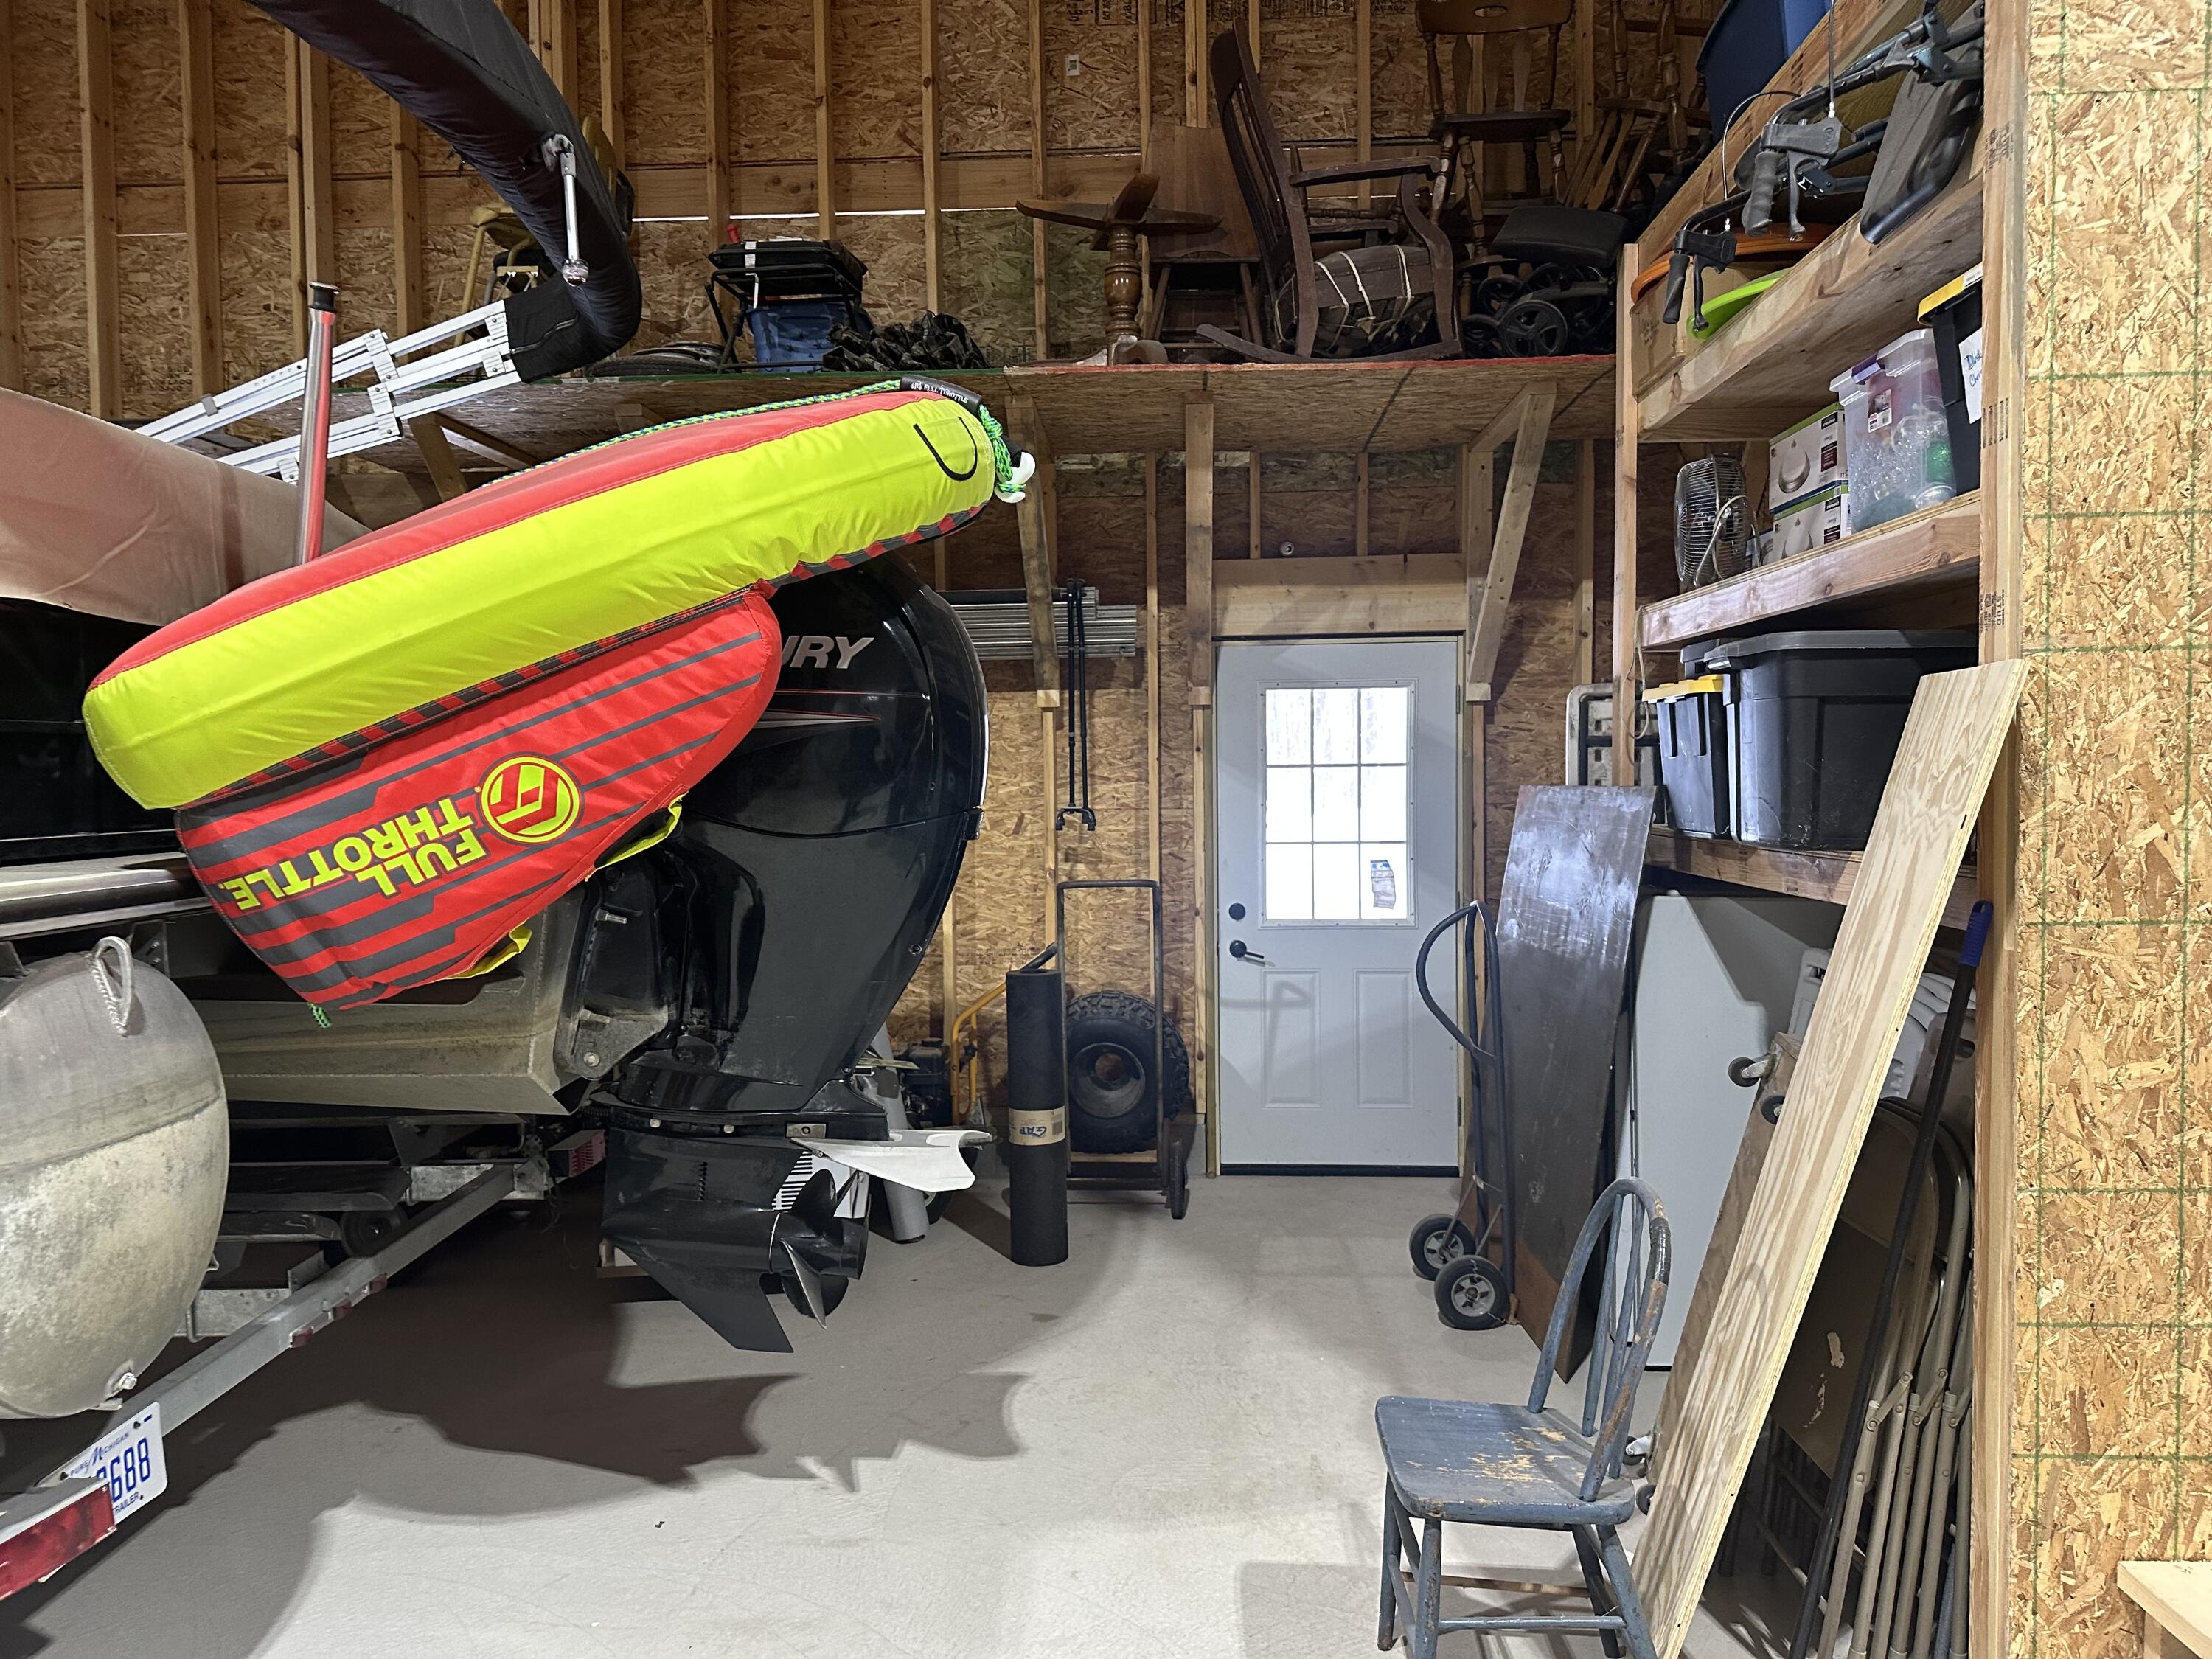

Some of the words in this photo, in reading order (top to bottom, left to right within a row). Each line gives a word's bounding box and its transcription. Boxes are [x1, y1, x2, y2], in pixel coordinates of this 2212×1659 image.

[923, 383, 939, 393] FULL
[939, 384, 969, 404] THROTTLE
[223, 798, 473, 911] THROTTLE
[355, 830, 487, 897] FULL
[70, 1460, 90, 1475] PURE
